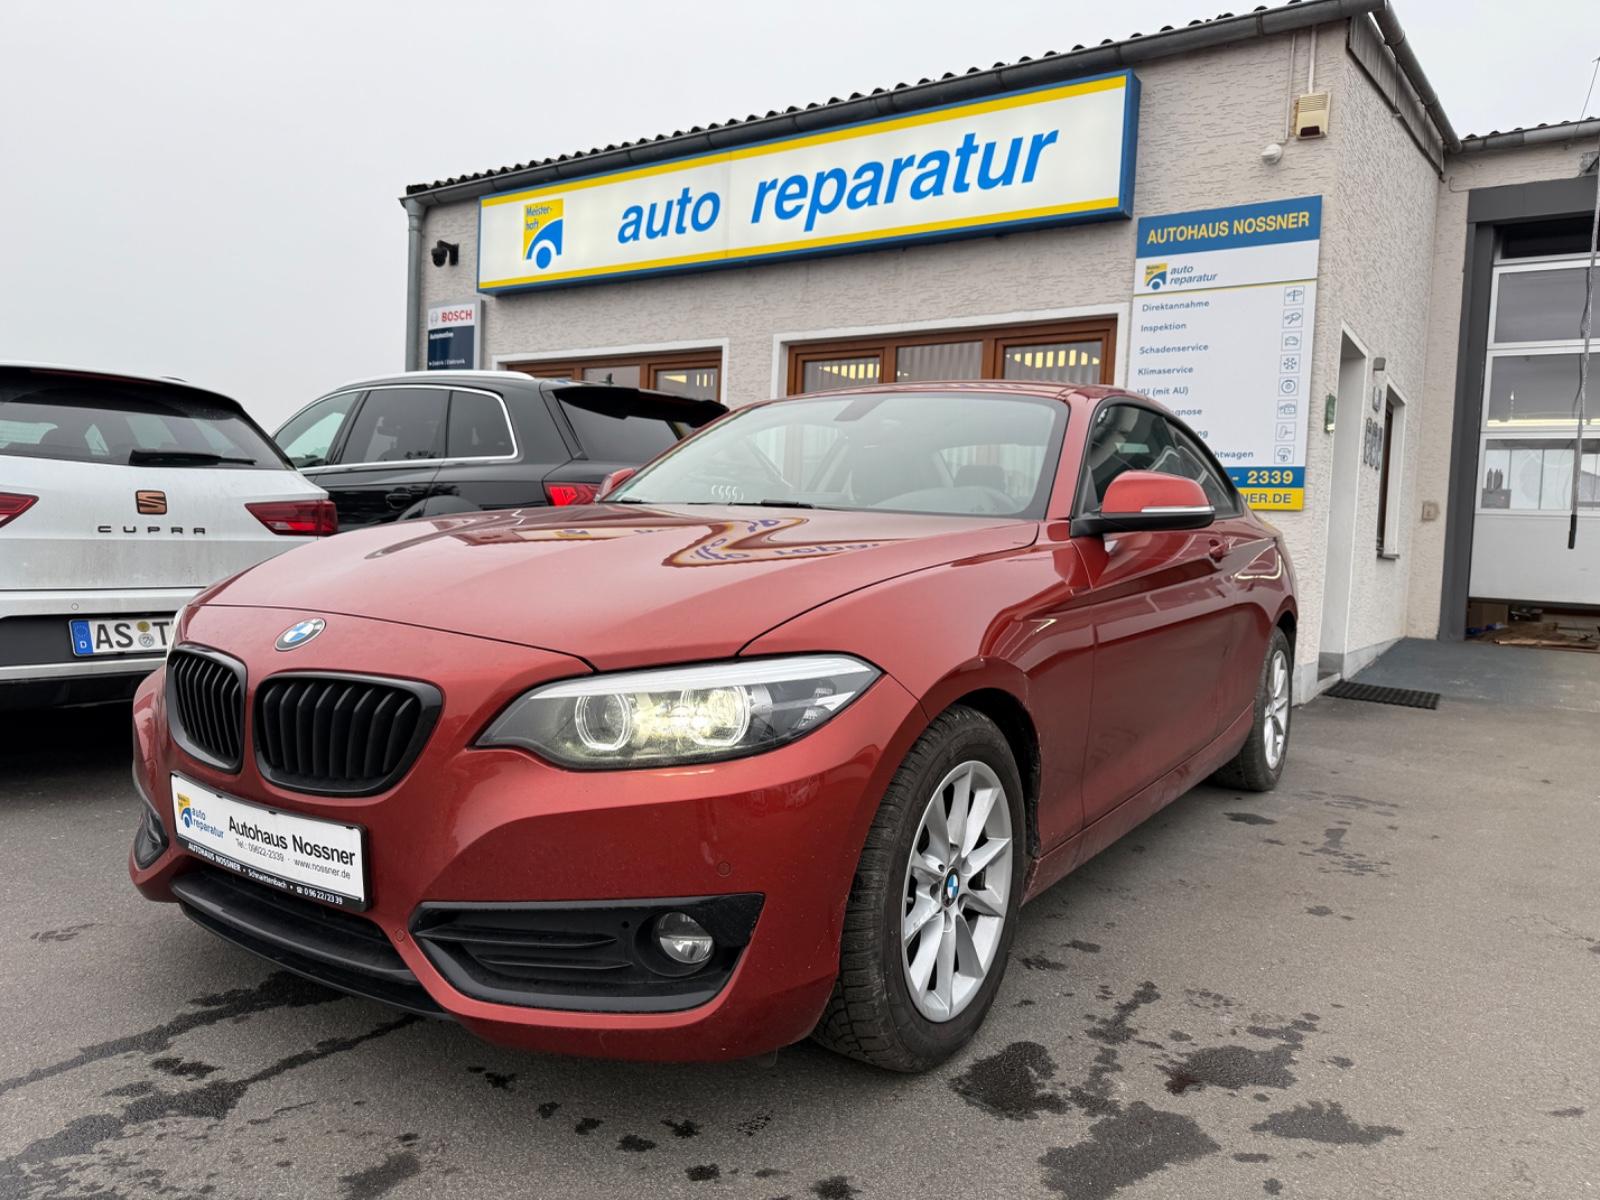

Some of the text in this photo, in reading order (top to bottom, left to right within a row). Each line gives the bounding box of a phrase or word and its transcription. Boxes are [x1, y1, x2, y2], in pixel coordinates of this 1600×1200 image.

[618, 130, 1059, 244] auto reparatur
[1146, 211, 1310, 245] AUTOHAUS NOSSNER
[1170, 265, 1194, 275] auto
[1169, 273, 1218, 286] reparatur
[1142, 301, 1210, 312] Direktannahme
[441, 309, 473, 322] BOSCH
[1140, 322, 1187, 333] Inspektion
[1139, 343, 1209, 355] Schadenservice
[1137, 366, 1194, 376] Klimaservice
[1152, 387, 1169, 397] (mit
[1172, 386, 1189, 396] AU)
[1247, 470, 1293, 484] 2339
[97, 525, 206, 535] CUPRA
[96, 623, 133, 650] AS
[152, 621, 173, 646] T
[192, 808, 206, 821] auto
[193, 819, 224, 838] reparatur
[229, 816, 356, 866] Autohaus Nossner
[215, 855, 241, 872] NOSSNER
